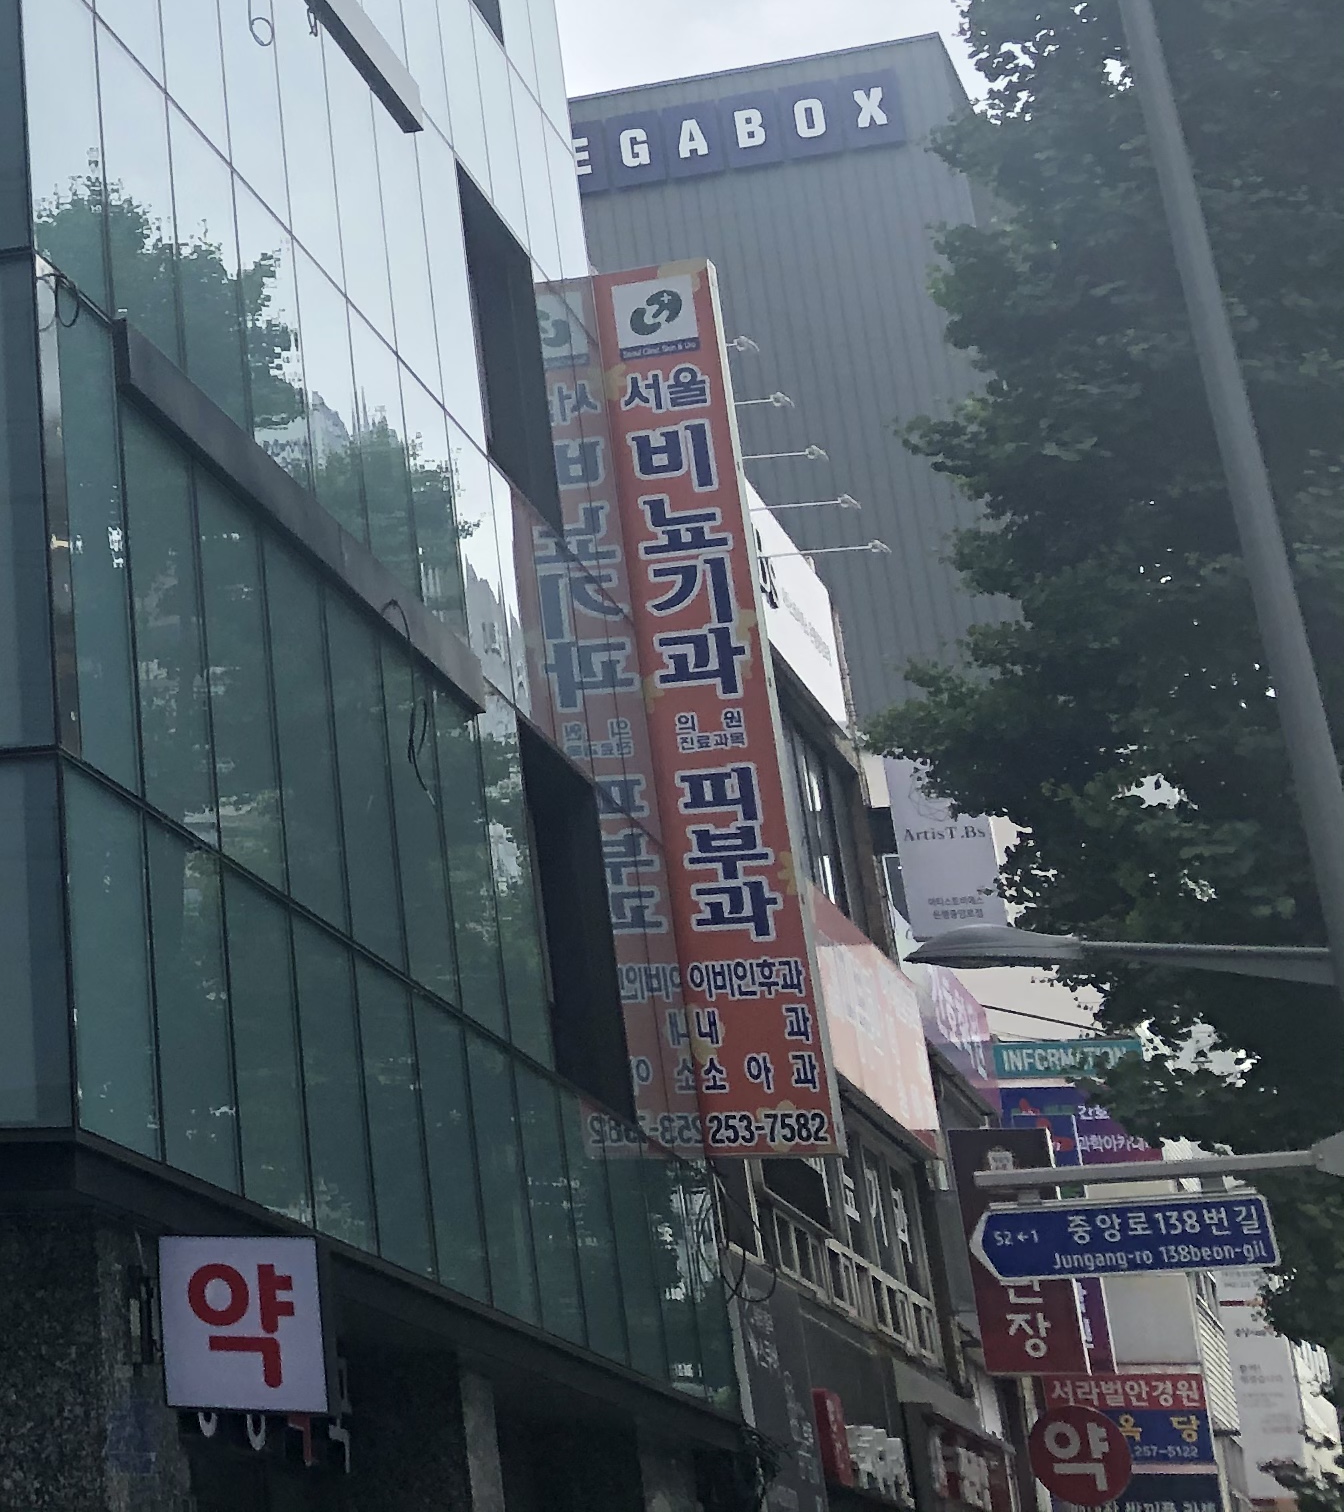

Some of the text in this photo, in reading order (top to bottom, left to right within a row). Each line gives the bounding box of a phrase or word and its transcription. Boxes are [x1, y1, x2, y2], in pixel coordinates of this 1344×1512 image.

[622, 365, 709, 411] 서울
[629, 420, 748, 696] 비뇨기과
[679, 766, 779, 937] 피부과
[689, 959, 804, 999] 이비인후과
[1002, 1046, 1127, 1072] INFORMTON
[709, 1111, 829, 1144] 253-7582
[1052, 1240, 1268, 1271] Jungang-ro 138beon-gil
[187, 1262, 295, 1388] 약
[1051, 1379, 1201, 1407] 서라벌안경원
[1044, 1421, 1110, 1492] 약
[1134, 1445, 1199, 1459] 257-5122
